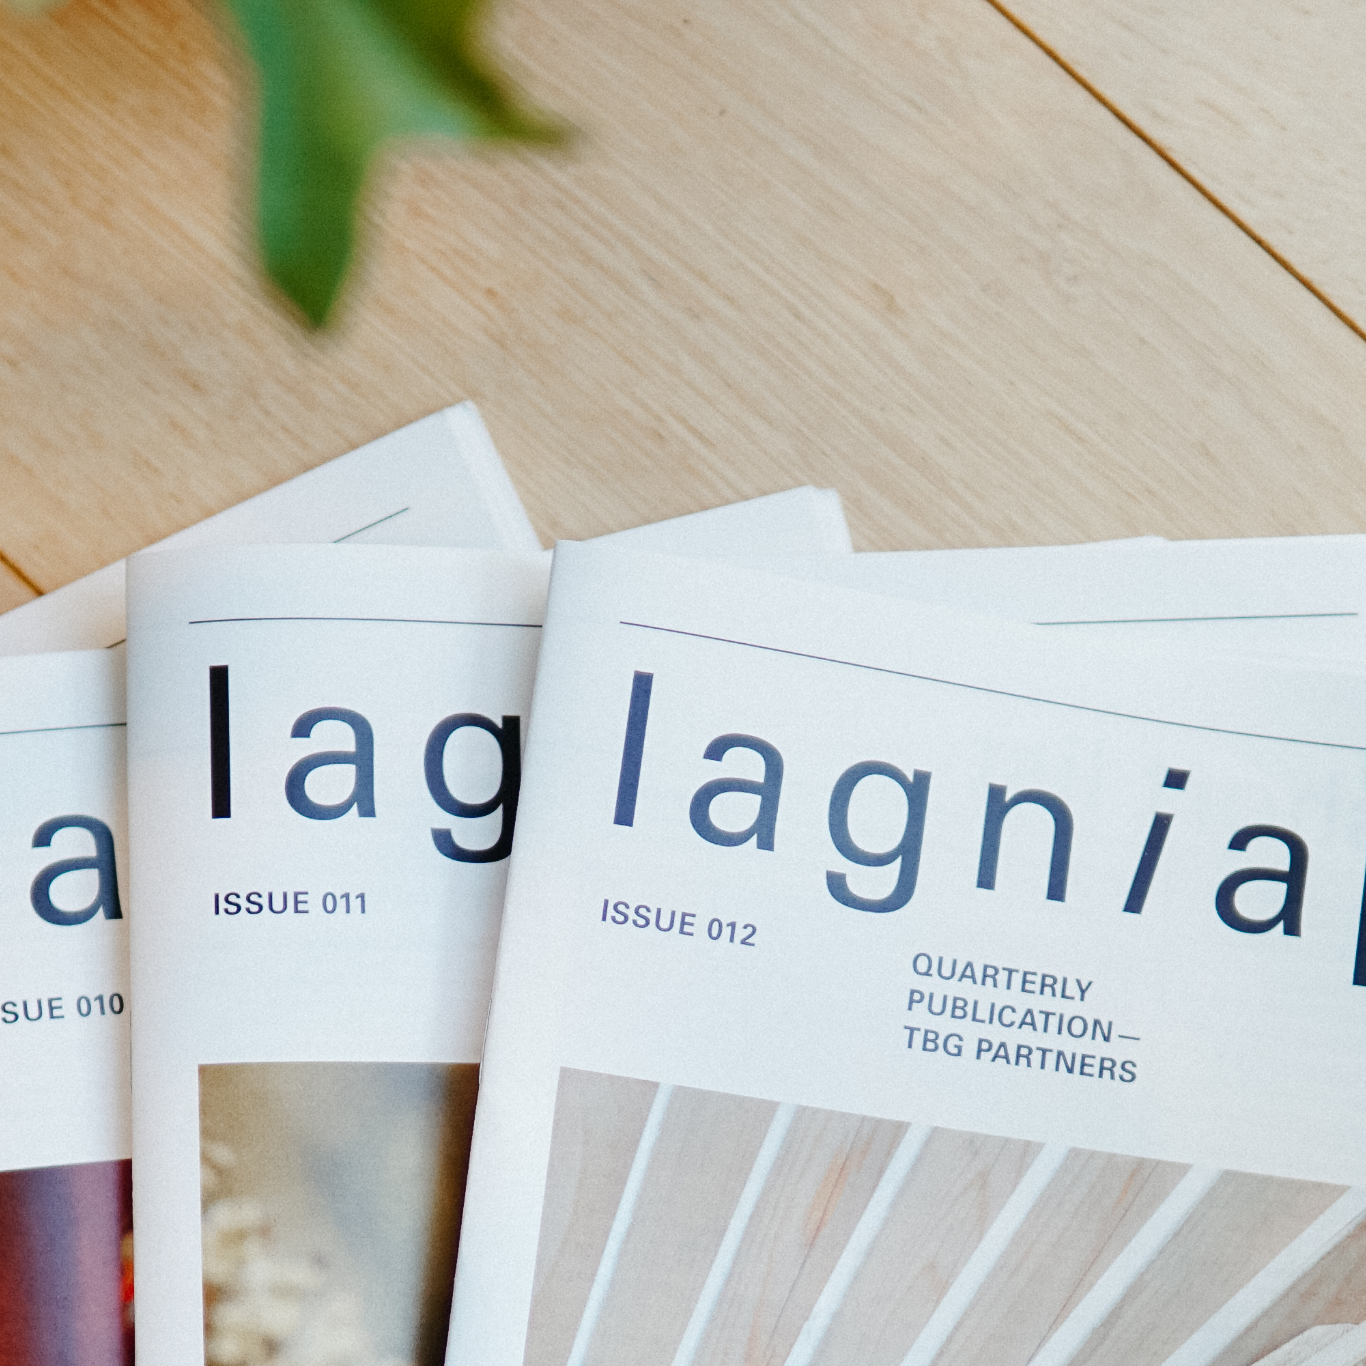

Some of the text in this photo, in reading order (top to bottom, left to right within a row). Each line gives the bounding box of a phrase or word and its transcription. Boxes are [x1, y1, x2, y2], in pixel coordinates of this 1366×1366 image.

[209, 664, 522, 864] lag
[213, 891, 368, 916] ISSUE 011
[600, 898, 758, 947] ISSUE 012
[911, 952, 1094, 1003] QUARTERLY
[76, 992, 125, 1018] 010
[903, 1025, 1138, 1084] TBG PARTNERS
